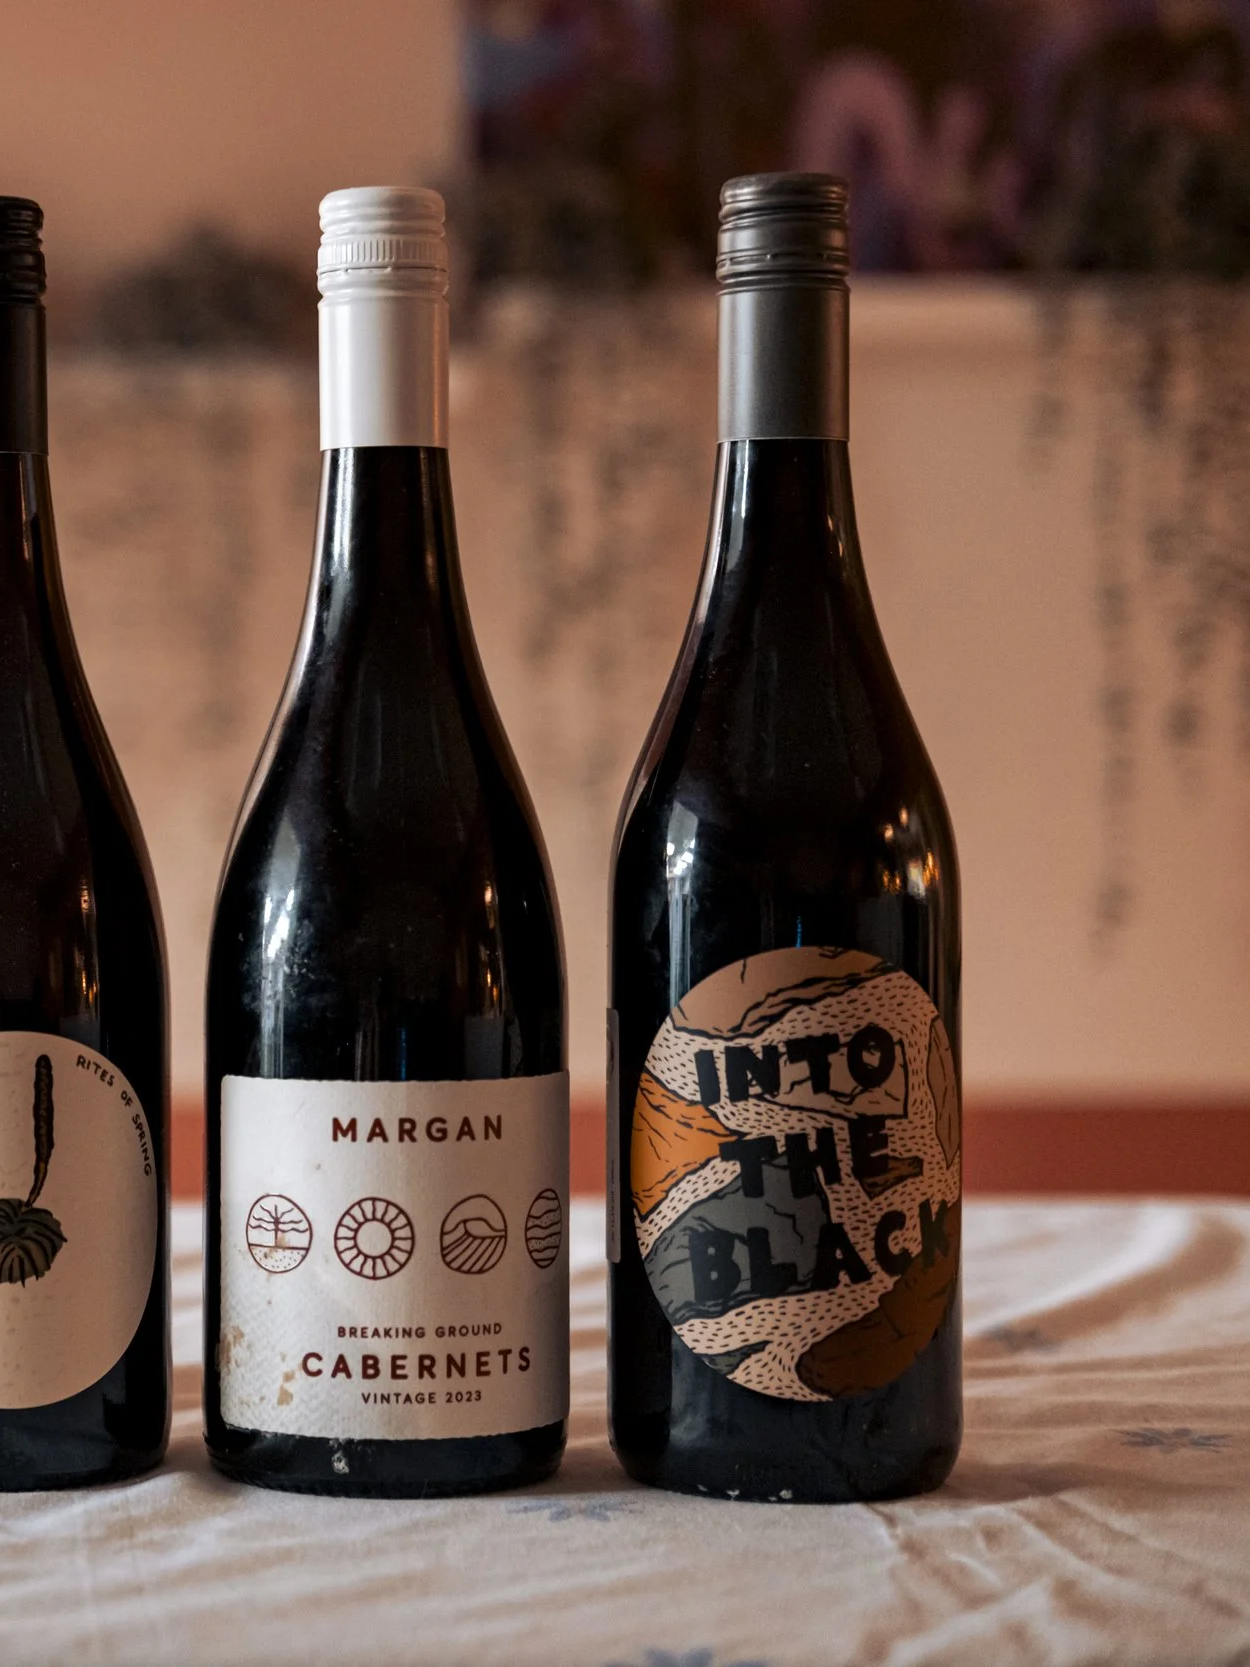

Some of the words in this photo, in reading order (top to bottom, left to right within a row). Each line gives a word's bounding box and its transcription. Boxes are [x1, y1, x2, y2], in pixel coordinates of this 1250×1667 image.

[693, 1022, 898, 1108] INTO
[76, 1054, 115, 1088] RITES
[120, 1090, 133, 1108] OF
[131, 1112, 153, 1177] SPRING
[332, 1115, 503, 1143] MARGAN
[719, 1116, 892, 1200] THE
[688, 1199, 952, 1302] BLACK
[337, 1325, 426, 1339] BREAKING
[435, 1322, 503, 1339] GROUND
[302, 1347, 532, 1380] CABERNETS
[362, 1391, 437, 1405] VINTAGE
[445, 1390, 482, 1403] 2023
